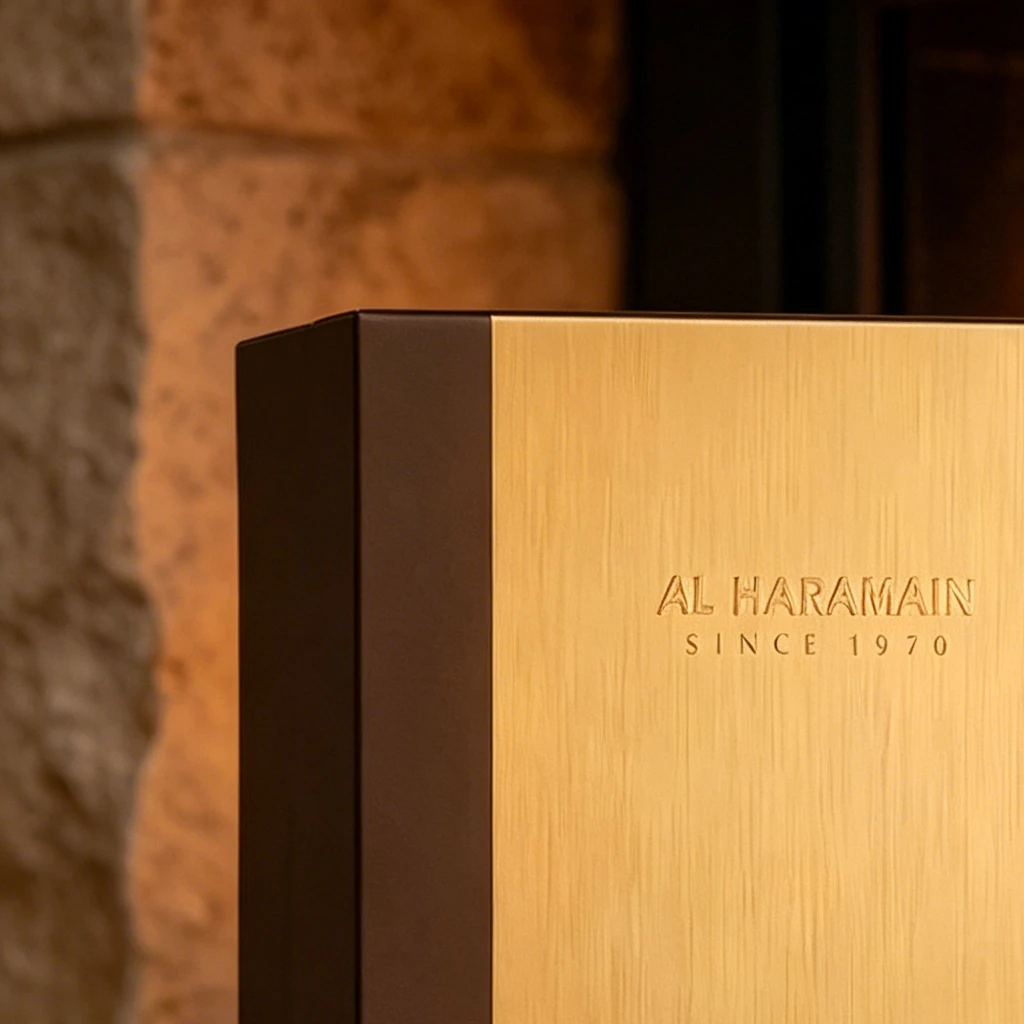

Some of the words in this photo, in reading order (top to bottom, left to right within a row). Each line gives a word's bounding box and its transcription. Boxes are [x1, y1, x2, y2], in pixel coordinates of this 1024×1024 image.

[657, 575, 714, 616] AL
[733, 576, 975, 616] HARAMAIN
[686, 633, 816, 655] SINCE
[849, 634, 947, 656] 1970
